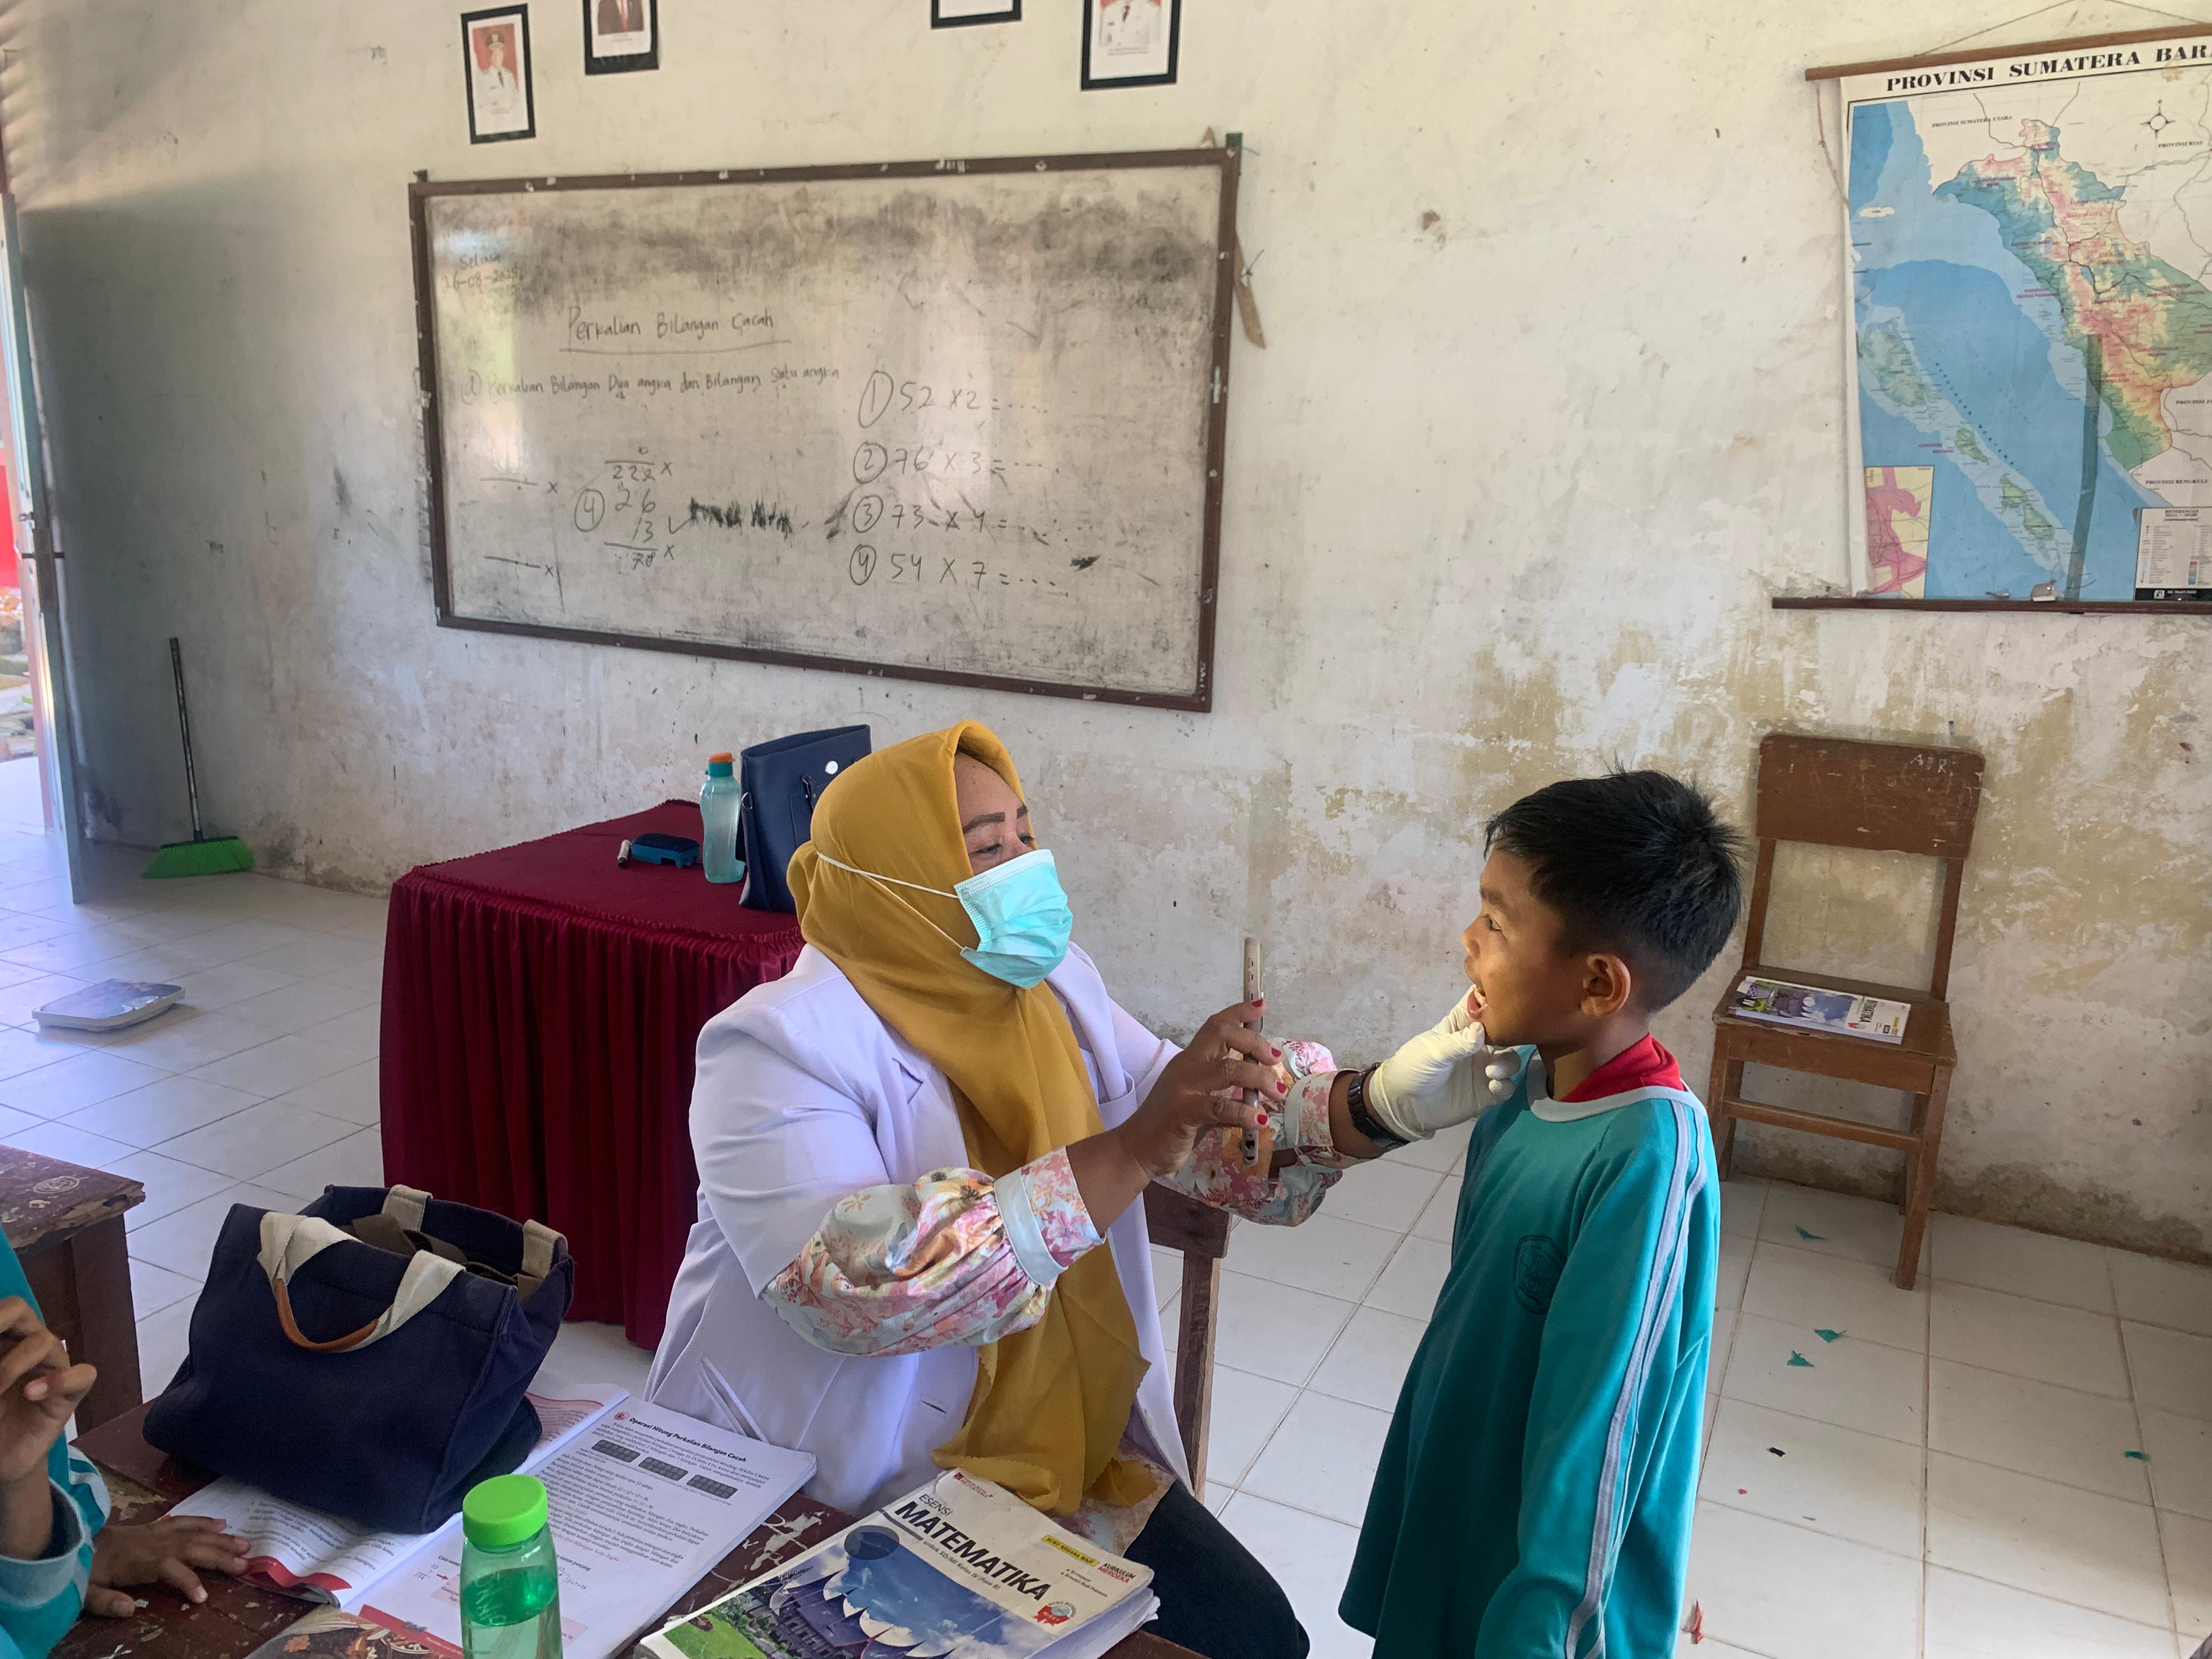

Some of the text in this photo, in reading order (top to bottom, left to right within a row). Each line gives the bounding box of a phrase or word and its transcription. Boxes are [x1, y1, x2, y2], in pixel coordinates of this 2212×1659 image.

[1887, 43, 2212, 91] PROVINSI SUMATERA BAR
[569, 306, 641, 352] Perkalian
[899, 381, 933, 411] 52
[894, 447, 929, 473] 76
[970, 450, 981, 473] 3
[891, 505, 924, 529] 73
[890, 553, 923, 581] 54
[972, 562, 987, 590] 7
[629, 1417, 653, 1433] Operasi
[652, 1425, 672, 1438] Hitung
[672, 1433, 702, 1448] Perkalian
[701, 1443, 728, 1458] Bilangan
[727, 1452, 747, 1463] Cacah
[918, 1493, 953, 1516] ESENSI
[894, 1501, 1051, 1601] MATEMATIKA
[923, 1540, 941, 1553] untuk
[939, 1550, 958, 1565] SD/MI
[956, 1562, 972, 1576] Kelas
[1097, 1566, 1130, 1584] MERDEKA
[1103, 1562, 1136, 1579] KURIKULUM
